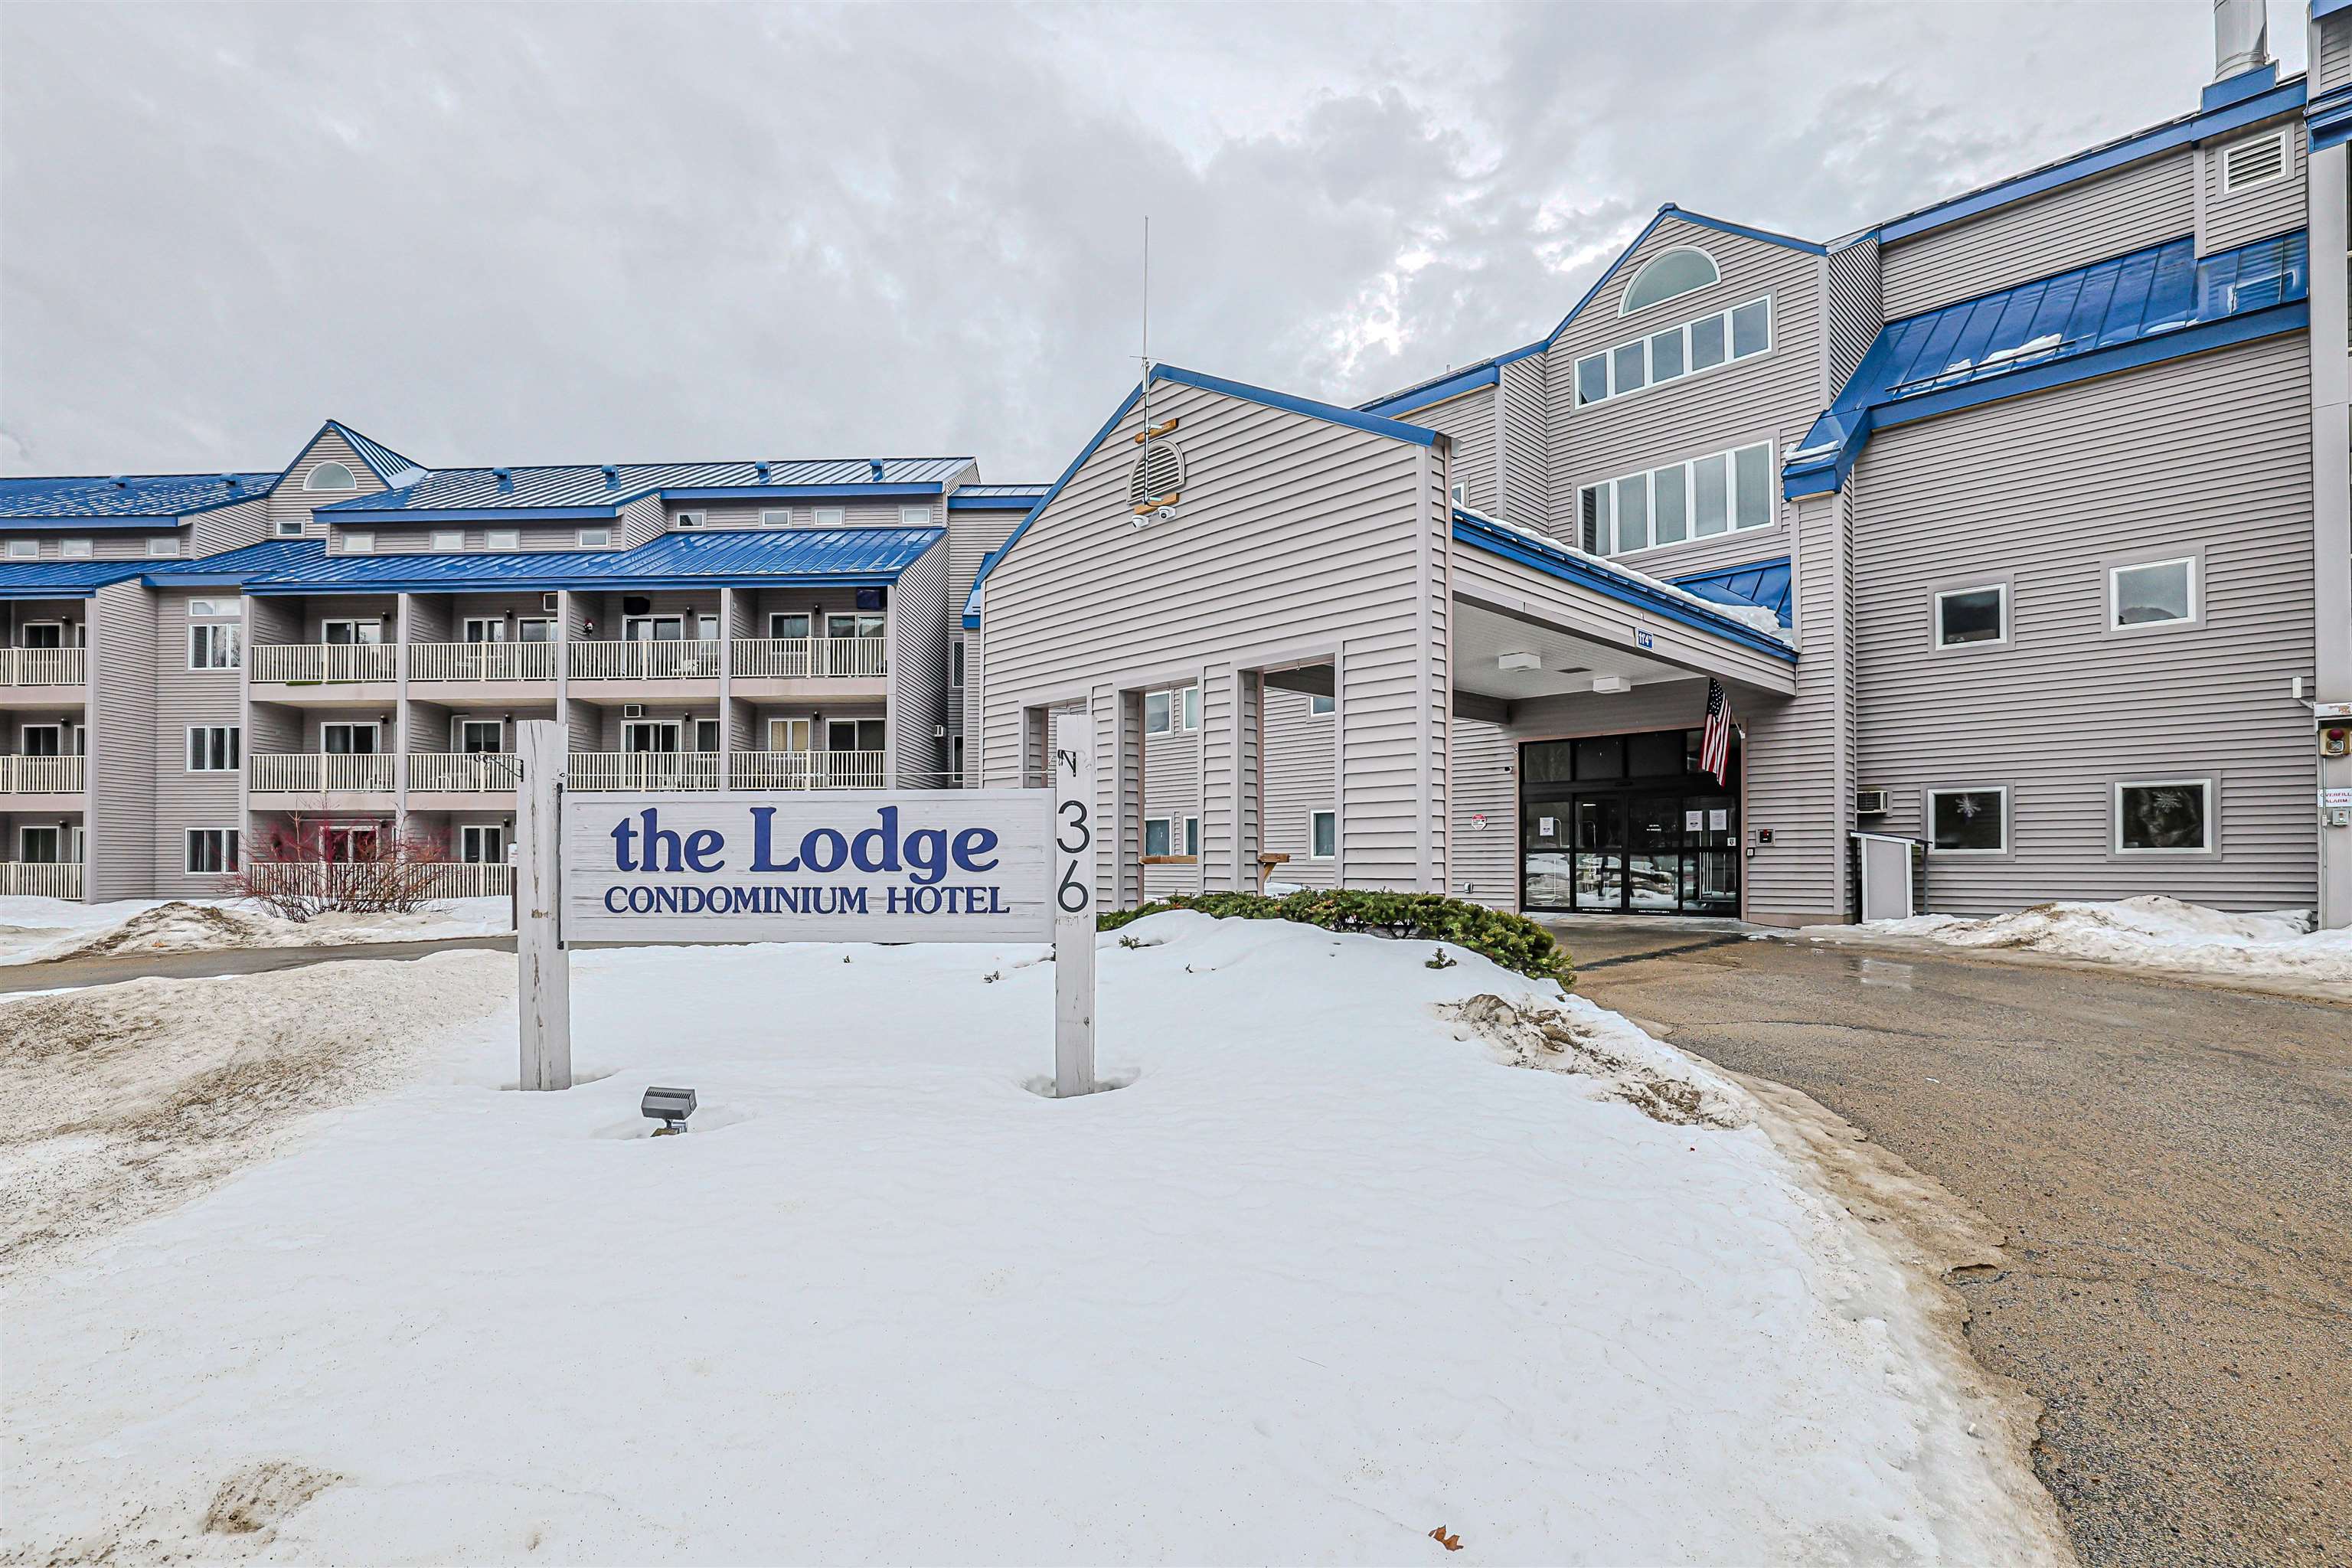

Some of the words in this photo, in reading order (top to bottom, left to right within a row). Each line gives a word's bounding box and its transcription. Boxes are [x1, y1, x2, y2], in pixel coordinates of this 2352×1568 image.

[611, 808, 724, 873] the
[750, 805, 999, 884] Lodge
[604, 886, 868, 914] CONDOMINIUM
[887, 886, 1011, 914] HOTEL
